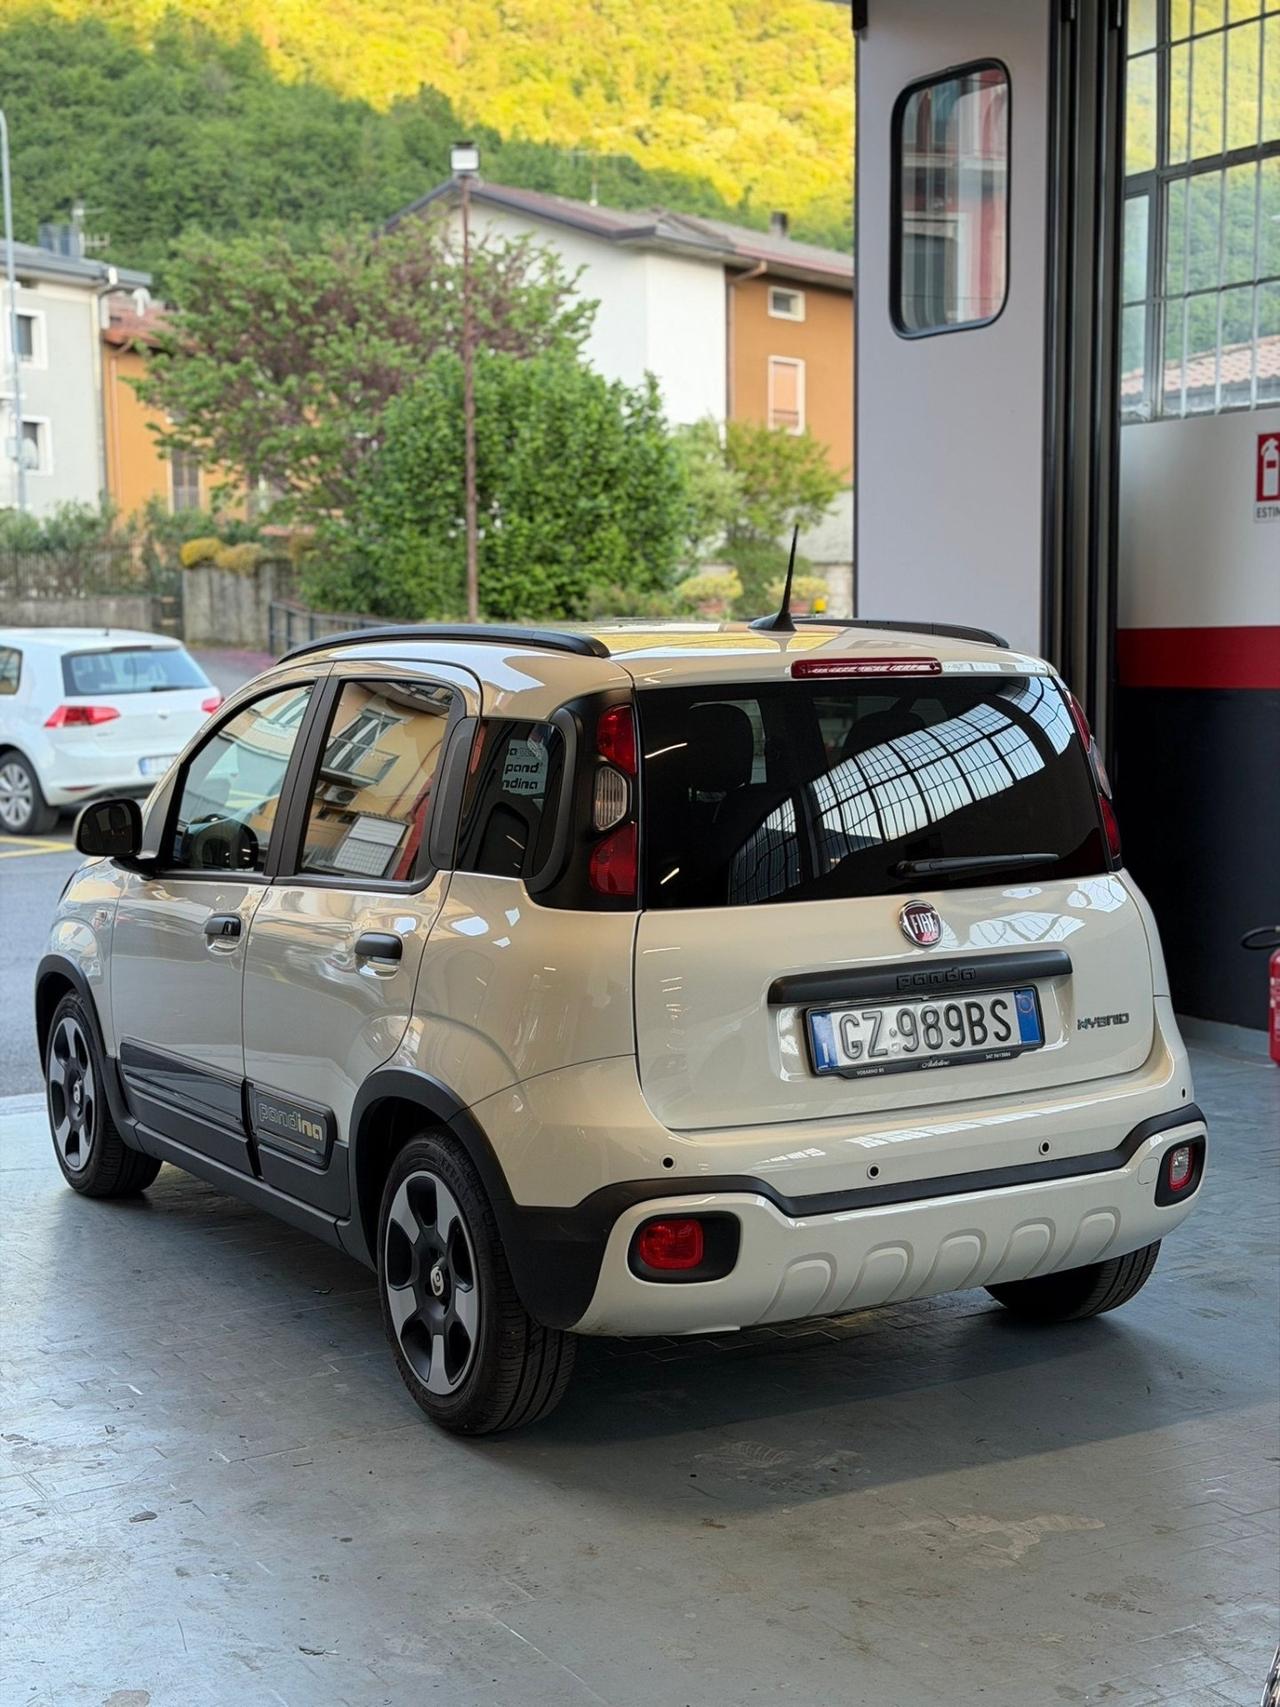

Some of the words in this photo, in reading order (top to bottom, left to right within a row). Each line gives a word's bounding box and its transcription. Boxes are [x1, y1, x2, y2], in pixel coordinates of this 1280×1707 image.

[909, 912, 935, 935] FIAT
[896, 966, 977, 991] panda
[839, 1010, 889, 1060] GZ
[895, 997, 1012, 1053] 989BS
[1077, 1012, 1130, 1031] HYBRID
[258, 1103, 323, 1141] pandina
